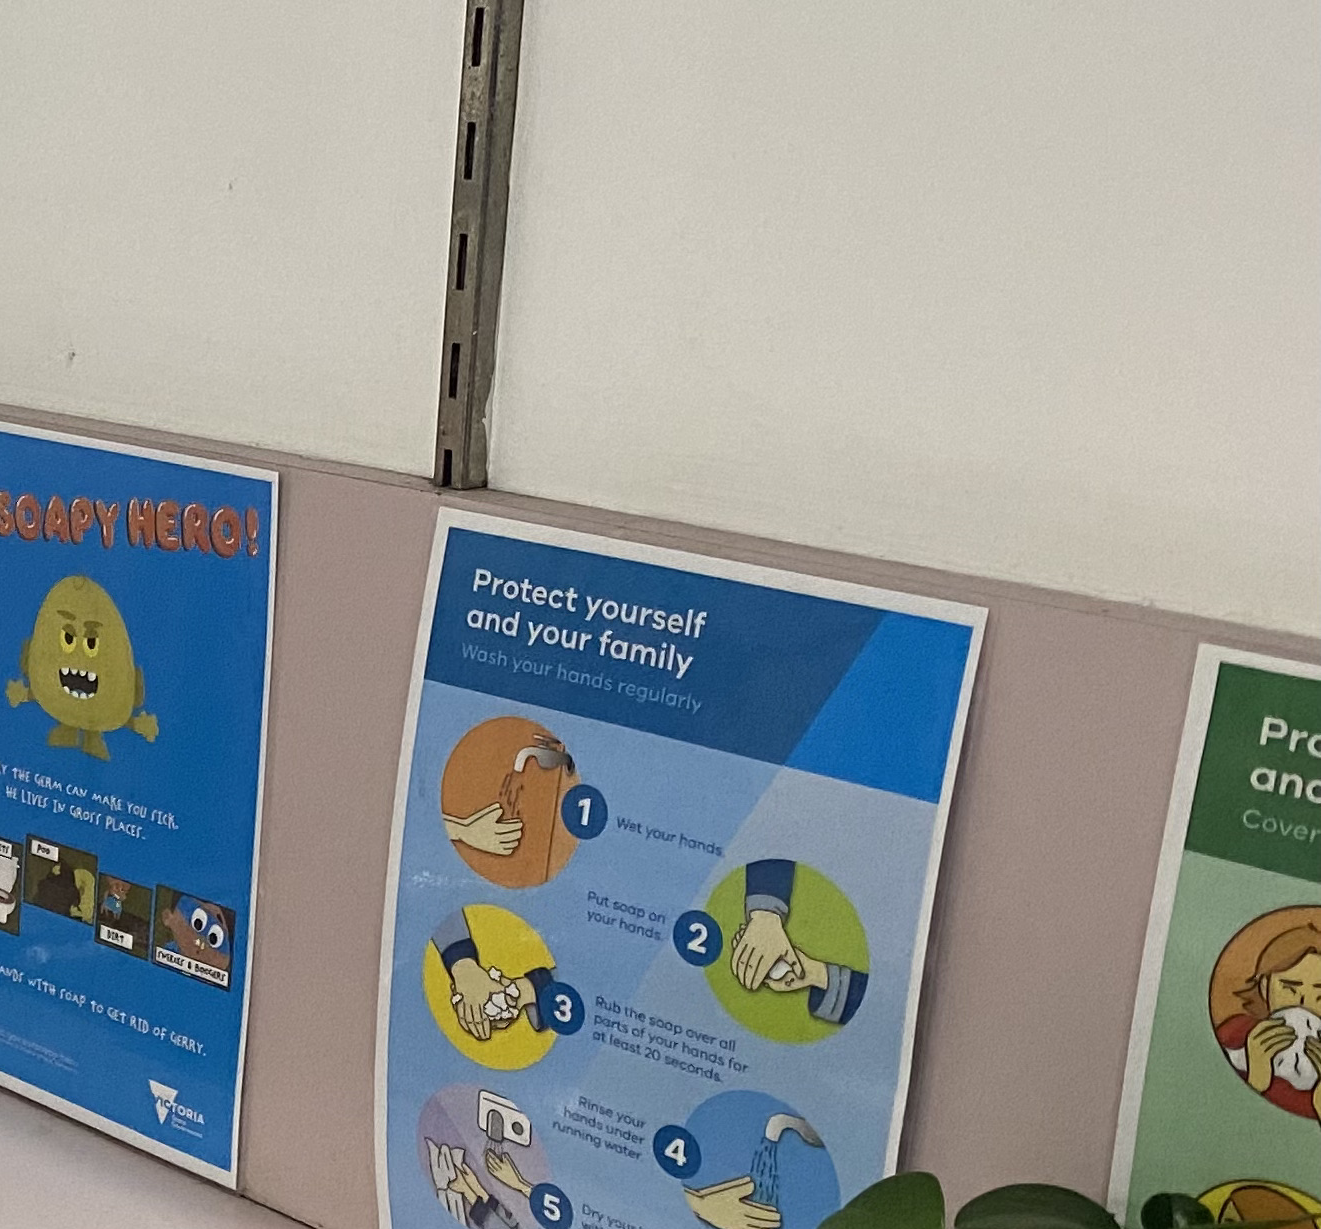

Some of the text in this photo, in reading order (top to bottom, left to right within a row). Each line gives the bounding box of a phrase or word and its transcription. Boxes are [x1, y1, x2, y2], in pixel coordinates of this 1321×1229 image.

[127, 498, 259, 558] HERO!
[473, 568, 707, 638] Protect yourself
[467, 609, 693, 679] and your family
[462, 643, 701, 715] Wash your hands regularly
[6, 786, 17, 800] HE
[21, 789, 49, 808] LIVES
[53, 800, 66, 813] IN
[70, 805, 101, 825] GROSS
[12, 767, 30, 783] THE
[34, 773, 62, 792] GERM
[66, 784, 87, 798] CAN
[92, 793, 122, 811] MAKE
[127, 802, 146, 819] YOU
[578, 798, 591, 826] 1
[617, 816, 642, 834] Wet
[646, 826, 676, 841] your
[587, 910, 616, 922] your
[588, 891, 665, 924] Put soap on
[687, 923, 708, 954] 2
[28, 978, 56, 996] WITH
[59, 989, 86, 1007] SOAP
[91, 1000, 103, 1013] TO
[107, 1006, 126, 1024] GET
[129, 1015, 149, 1034] RID
[153, 1027, 167, 1040] OF
[554, 994, 572, 1023] 3
[596, 996, 736, 1052] Rub the soap over all
[593, 1031, 606, 1042] at
[610, 1033, 642, 1055] least
[645, 1048, 661, 1061] 20
[594, 1014, 749, 1073] parts of your hands for
[564, 1106, 646, 1145] hands under
[579, 1096, 646, 1129] Rinse your
[553, 1120, 601, 1148] running
[664, 1138, 687, 1167] 4
[544, 1193, 561, 1221] 5
[582, 1203, 604, 1222] Dry
